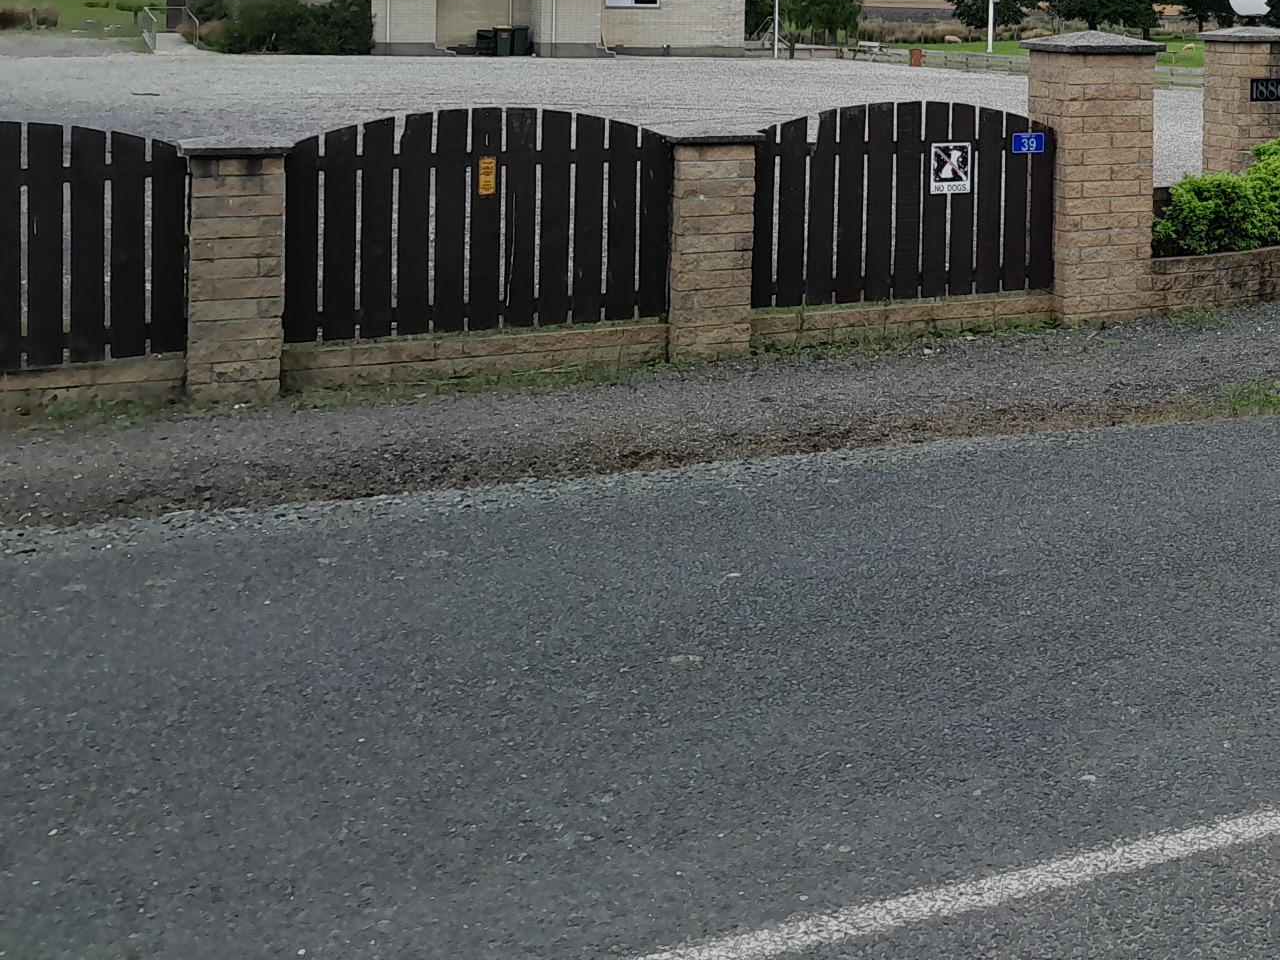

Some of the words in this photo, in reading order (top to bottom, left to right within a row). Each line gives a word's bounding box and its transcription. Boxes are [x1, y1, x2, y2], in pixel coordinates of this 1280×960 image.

[1021, 138, 1036, 151] 39
[934, 184, 945, 192] NO
[947, 184, 967, 192] DOGS
